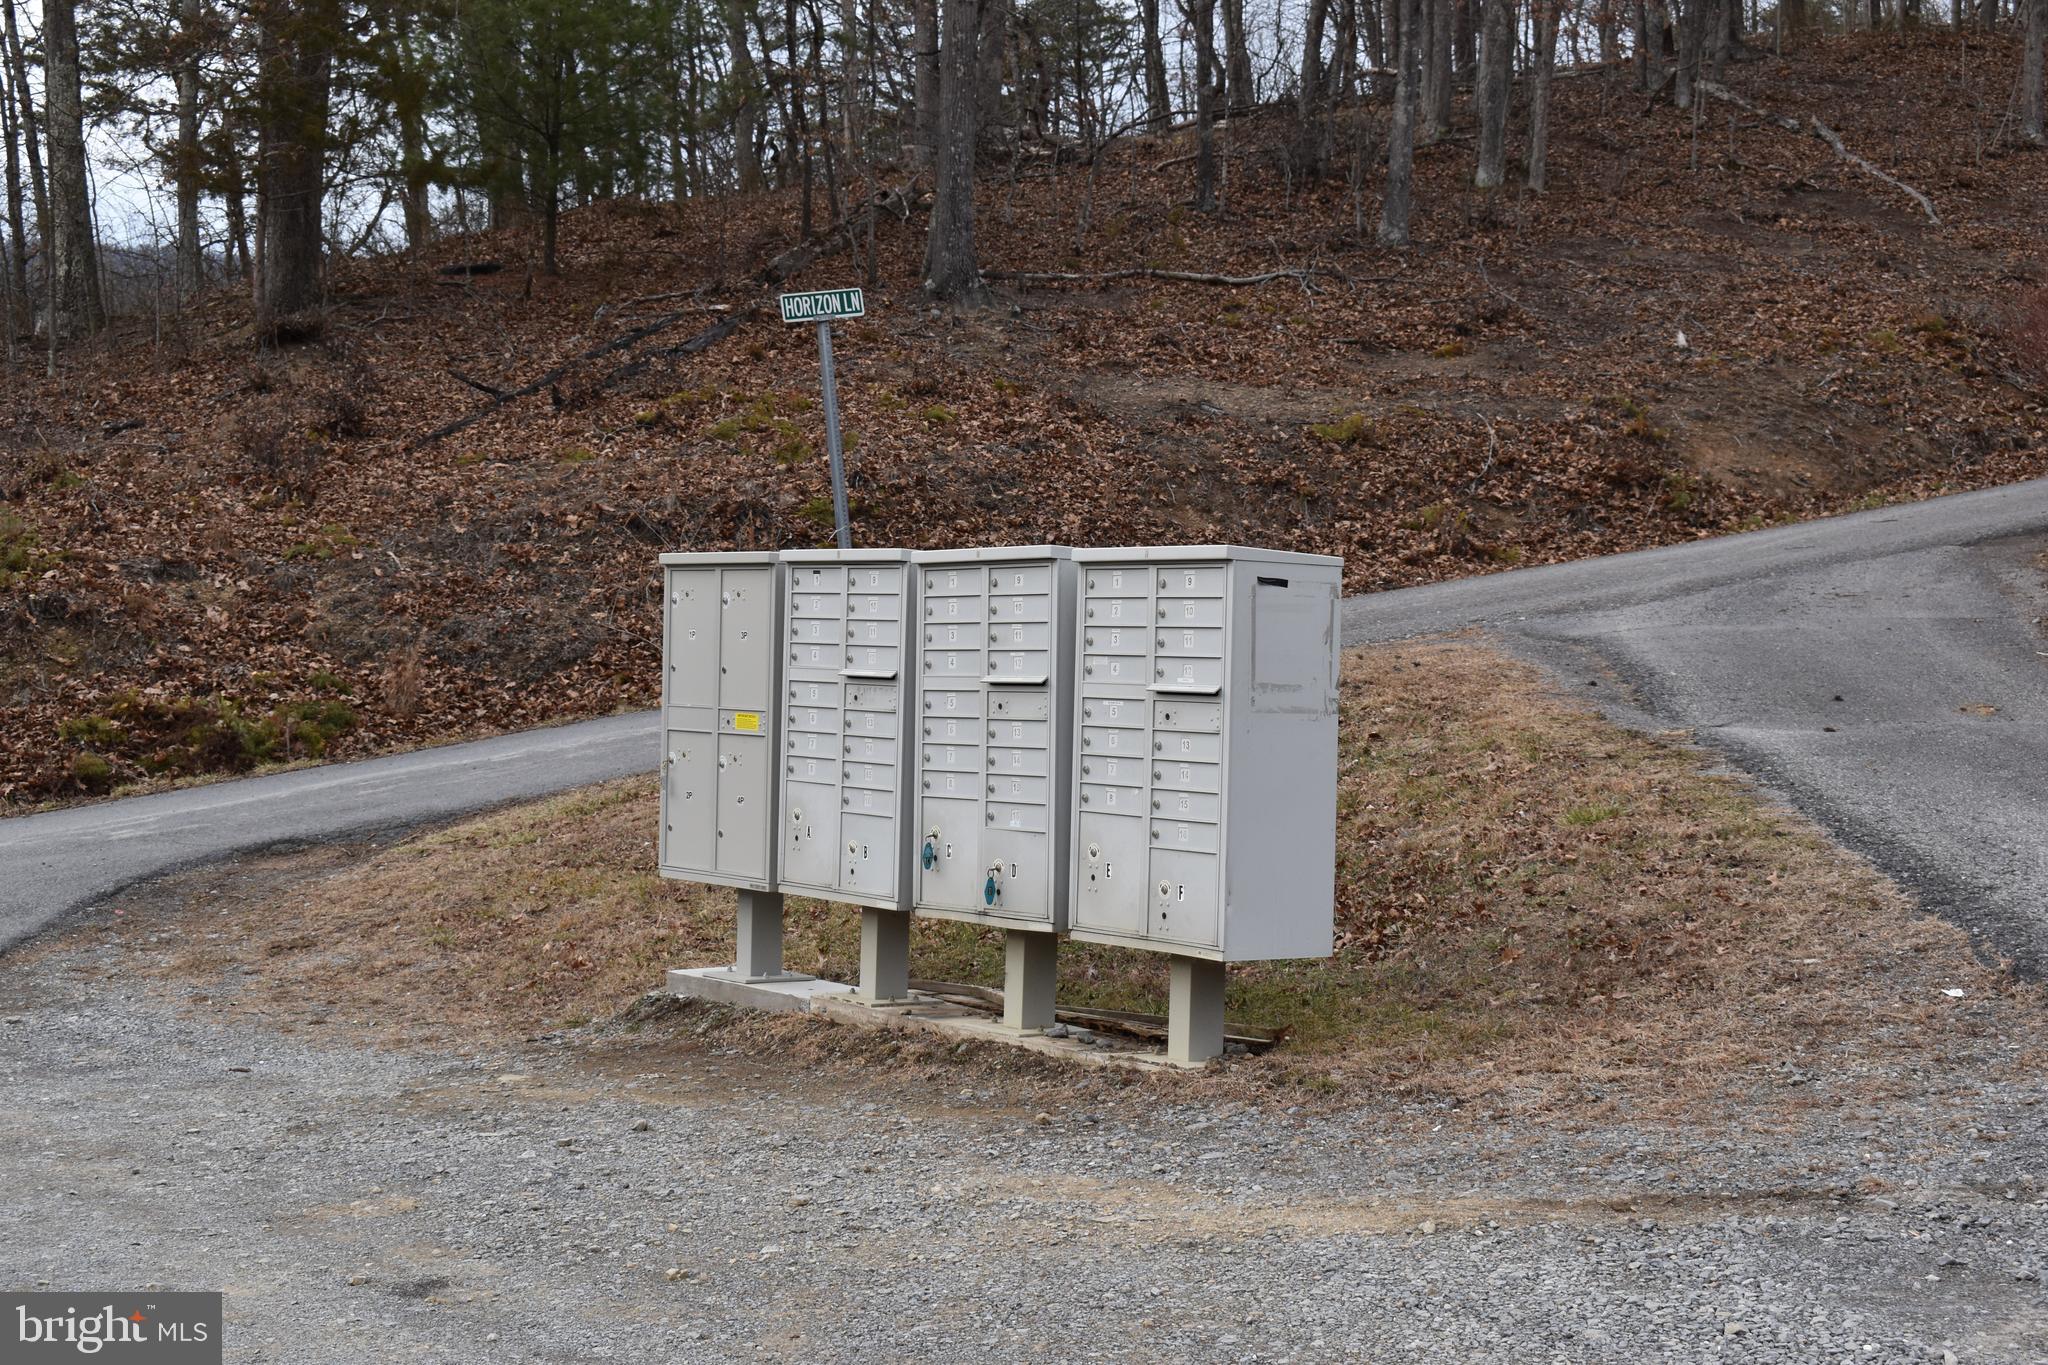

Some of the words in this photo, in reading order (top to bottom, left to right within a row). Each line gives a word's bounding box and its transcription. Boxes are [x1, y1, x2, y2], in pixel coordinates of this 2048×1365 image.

[784, 293, 842, 318] HORIZON
[842, 291, 861, 312] LN
[740, 630, 749, 640] 3P
[685, 791, 693, 800] 2P
[947, 844, 952, 858] C
[1011, 863, 1017, 878] D
[1106, 863, 1111, 878] E
[1178, 885, 1184, 901] F
